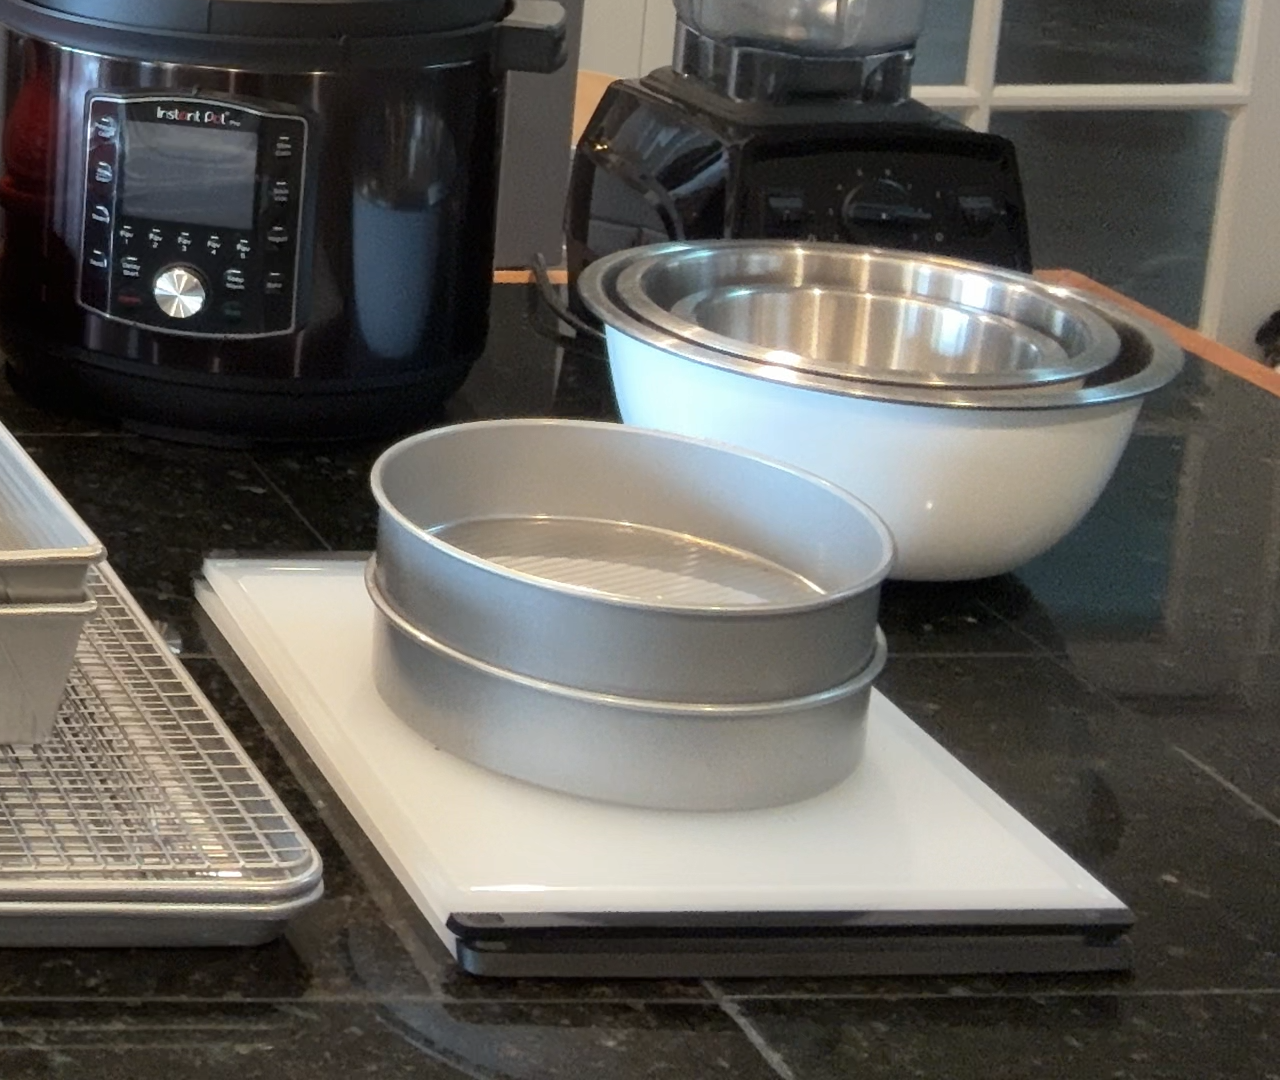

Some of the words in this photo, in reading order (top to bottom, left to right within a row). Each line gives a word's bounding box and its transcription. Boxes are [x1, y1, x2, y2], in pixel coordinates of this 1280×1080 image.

[156, 106, 200, 122] Instant
[148, 232, 163, 242] Fav
[177, 236, 192, 245] Fav
[207, 239, 221, 249] Fav
